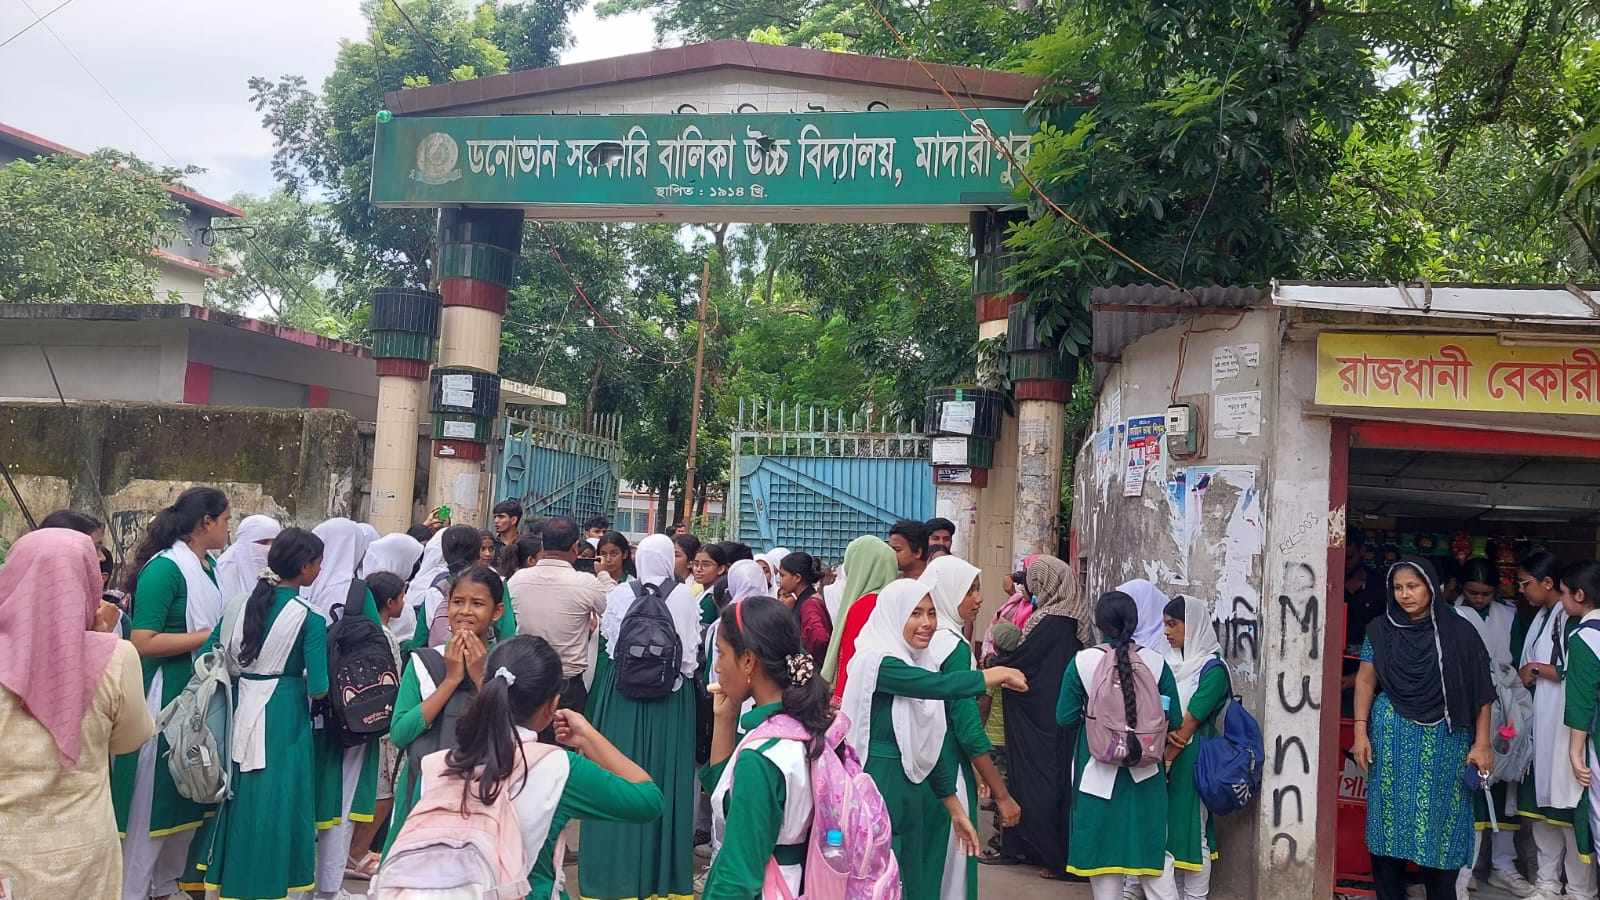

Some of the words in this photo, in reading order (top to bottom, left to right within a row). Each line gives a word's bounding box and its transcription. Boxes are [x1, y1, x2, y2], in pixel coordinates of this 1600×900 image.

[465, 135, 560, 180] ডনোভান
[656, 124, 737, 180] বালিকা
[797, 123, 904, 187] বিদ্যালয়,
[654, 184, 695, 199] স্থাপিত
[709, 186, 745, 197] ১৯১৪
[1335, 344, 1473, 400] রাজধানী
[1487, 347, 1600, 402] বেকারী
